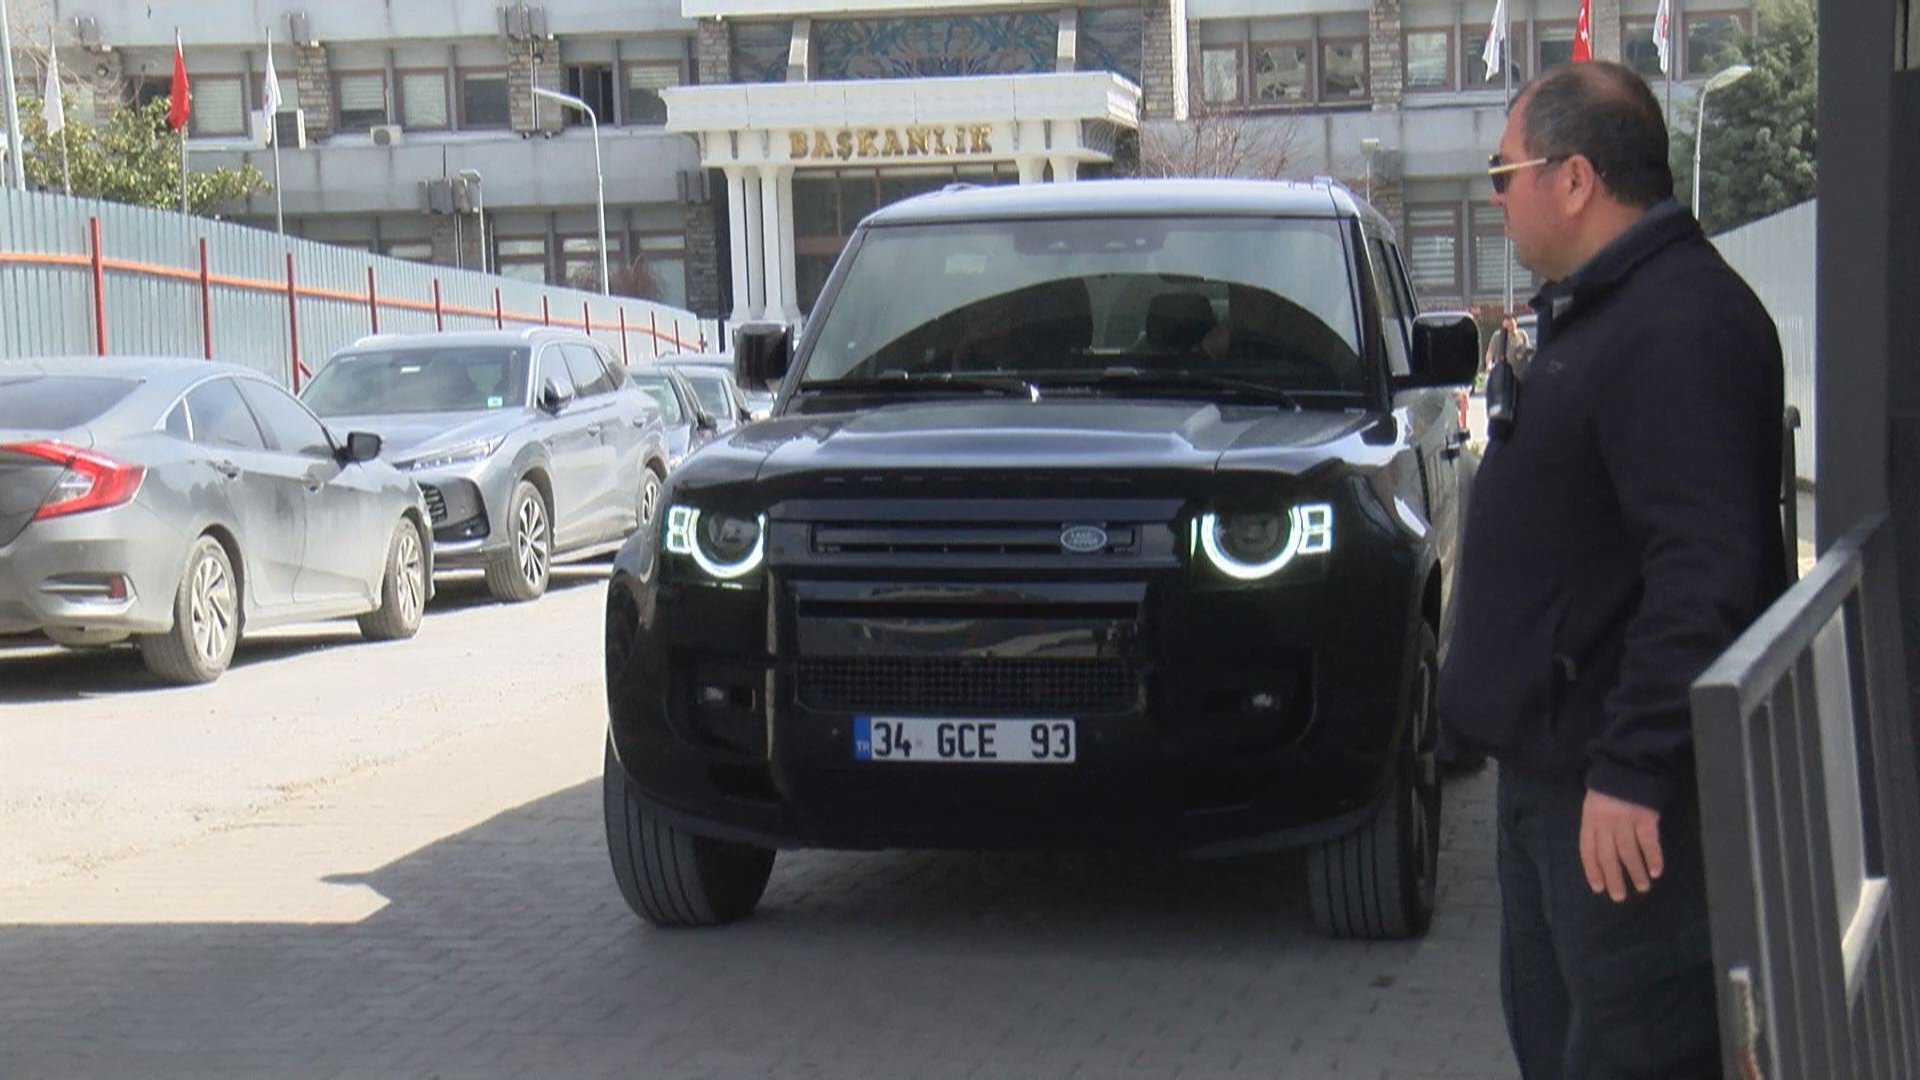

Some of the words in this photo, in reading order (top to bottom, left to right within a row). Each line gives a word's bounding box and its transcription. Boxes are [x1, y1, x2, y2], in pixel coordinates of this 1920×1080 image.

[788, 125, 993, 161] BAŞKANLIK
[873, 722, 912, 758] 34
[937, 722, 998, 759] GCE
[1030, 723, 1070, 759] 93
